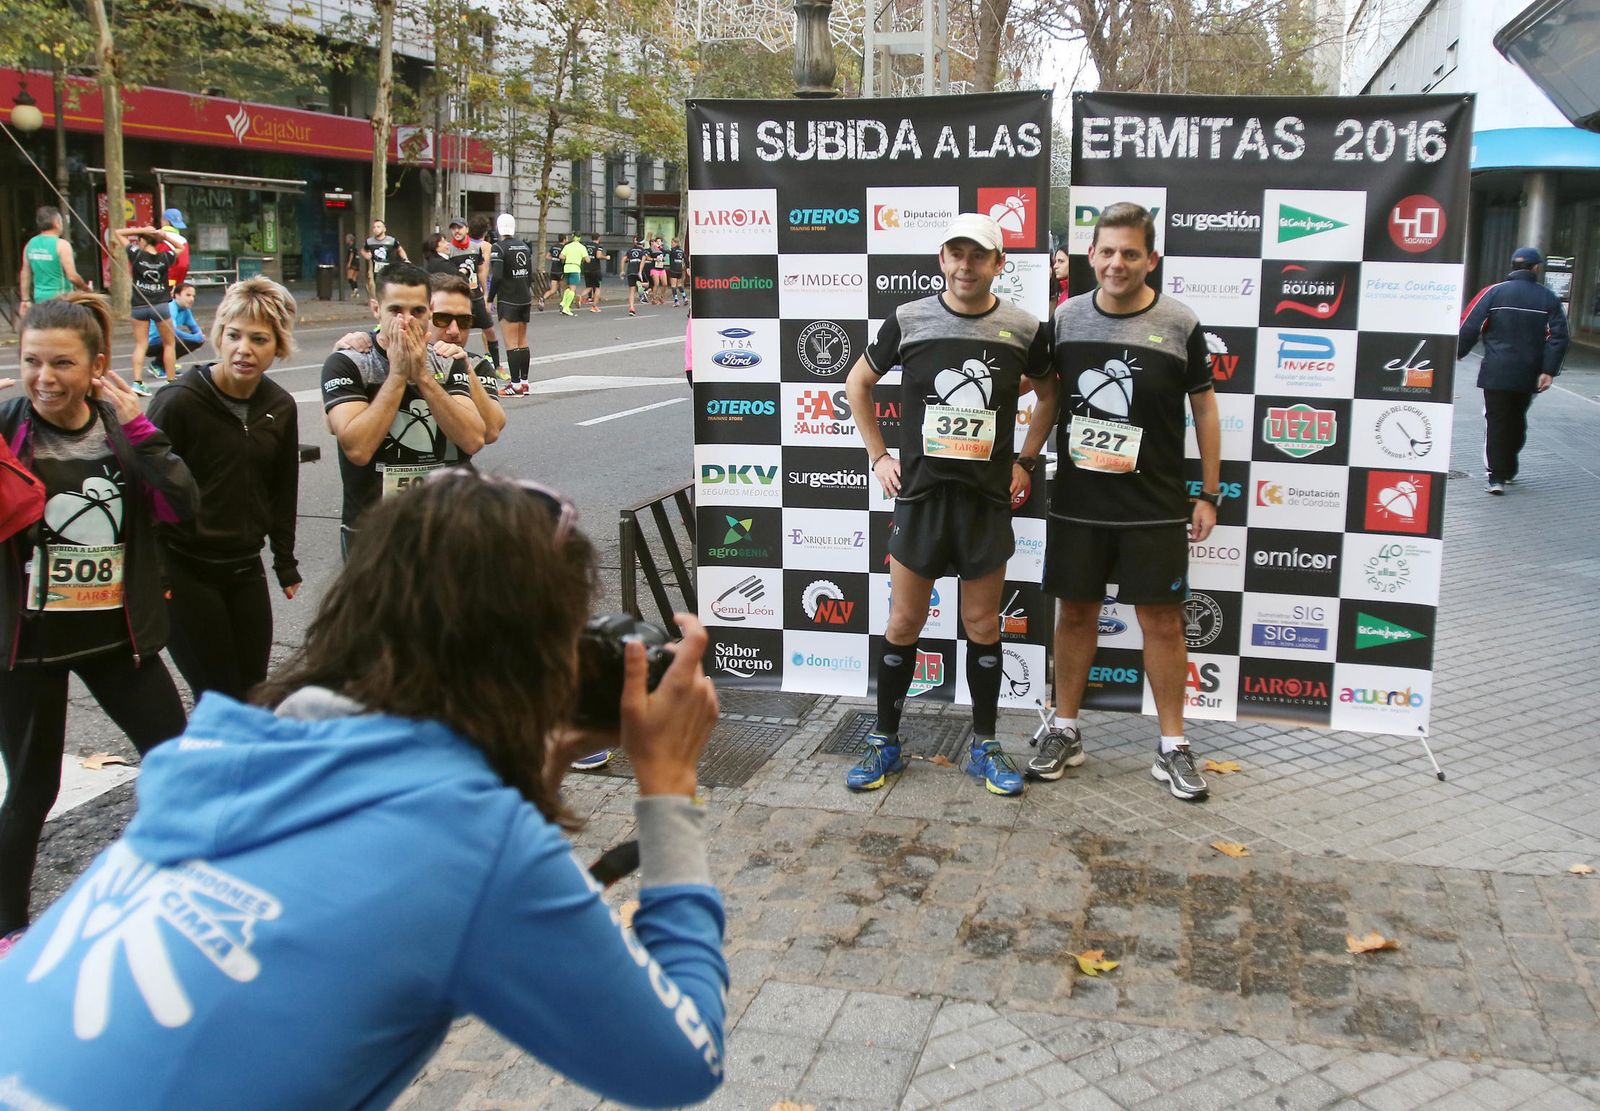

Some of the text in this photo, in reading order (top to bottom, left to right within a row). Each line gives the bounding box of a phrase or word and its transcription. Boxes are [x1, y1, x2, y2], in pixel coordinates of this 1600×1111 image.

[252, 114, 312, 143] CajaSur
[702, 118, 1042, 162] III SUBIDA A LAS
[1081, 115, 1448, 162] ERMITAS 2016
[694, 208, 773, 228] LAROJA
[788, 208, 861, 226] OTEROS
[903, 209, 952, 221] Diputación
[1171, 210, 1261, 231] surgestión
[903, 220, 916, 229] de
[801, 274, 864, 287] IMDECO
[1366, 278, 1457, 295] Pérez Couñago
[720, 339, 754, 349] TYSA
[721, 352, 752, 366] Ford
[706, 400, 777, 417] OTEROS
[1390, 406, 1403, 414] DEL
[1403, 405, 1424, 417] COCHE
[800, 421, 856, 435] AutoSur
[936, 416, 985, 438] 327
[1080, 427, 1128, 452] 227
[701, 464, 779, 485] DKV
[788, 470, 868, 488] surgestión
[701, 488, 740, 496] SEGUROS
[1288, 487, 1341, 501] Diputación
[1288, 498, 1301, 506] de
[1378, 544, 1403, 563] 40
[50, 558, 114, 583] 508
[711, 600, 775, 617] Gema León
[814, 598, 856, 625] NLV
[1292, 605, 1325, 622] SIG
[1264, 626, 1297, 642] SIG
[714, 642, 760, 659] Sabor
[714, 656, 773, 672] Moreno
[806, 653, 862, 672] dongrifo
[1090, 667, 1139, 685] EROS
[1243, 676, 1329, 699] LAROJA
[1243, 695, 1330, 707] CONSTRUCTORA
[1339, 685, 1424, 709] acuerdo
[162, 890, 236, 959] CIMA
